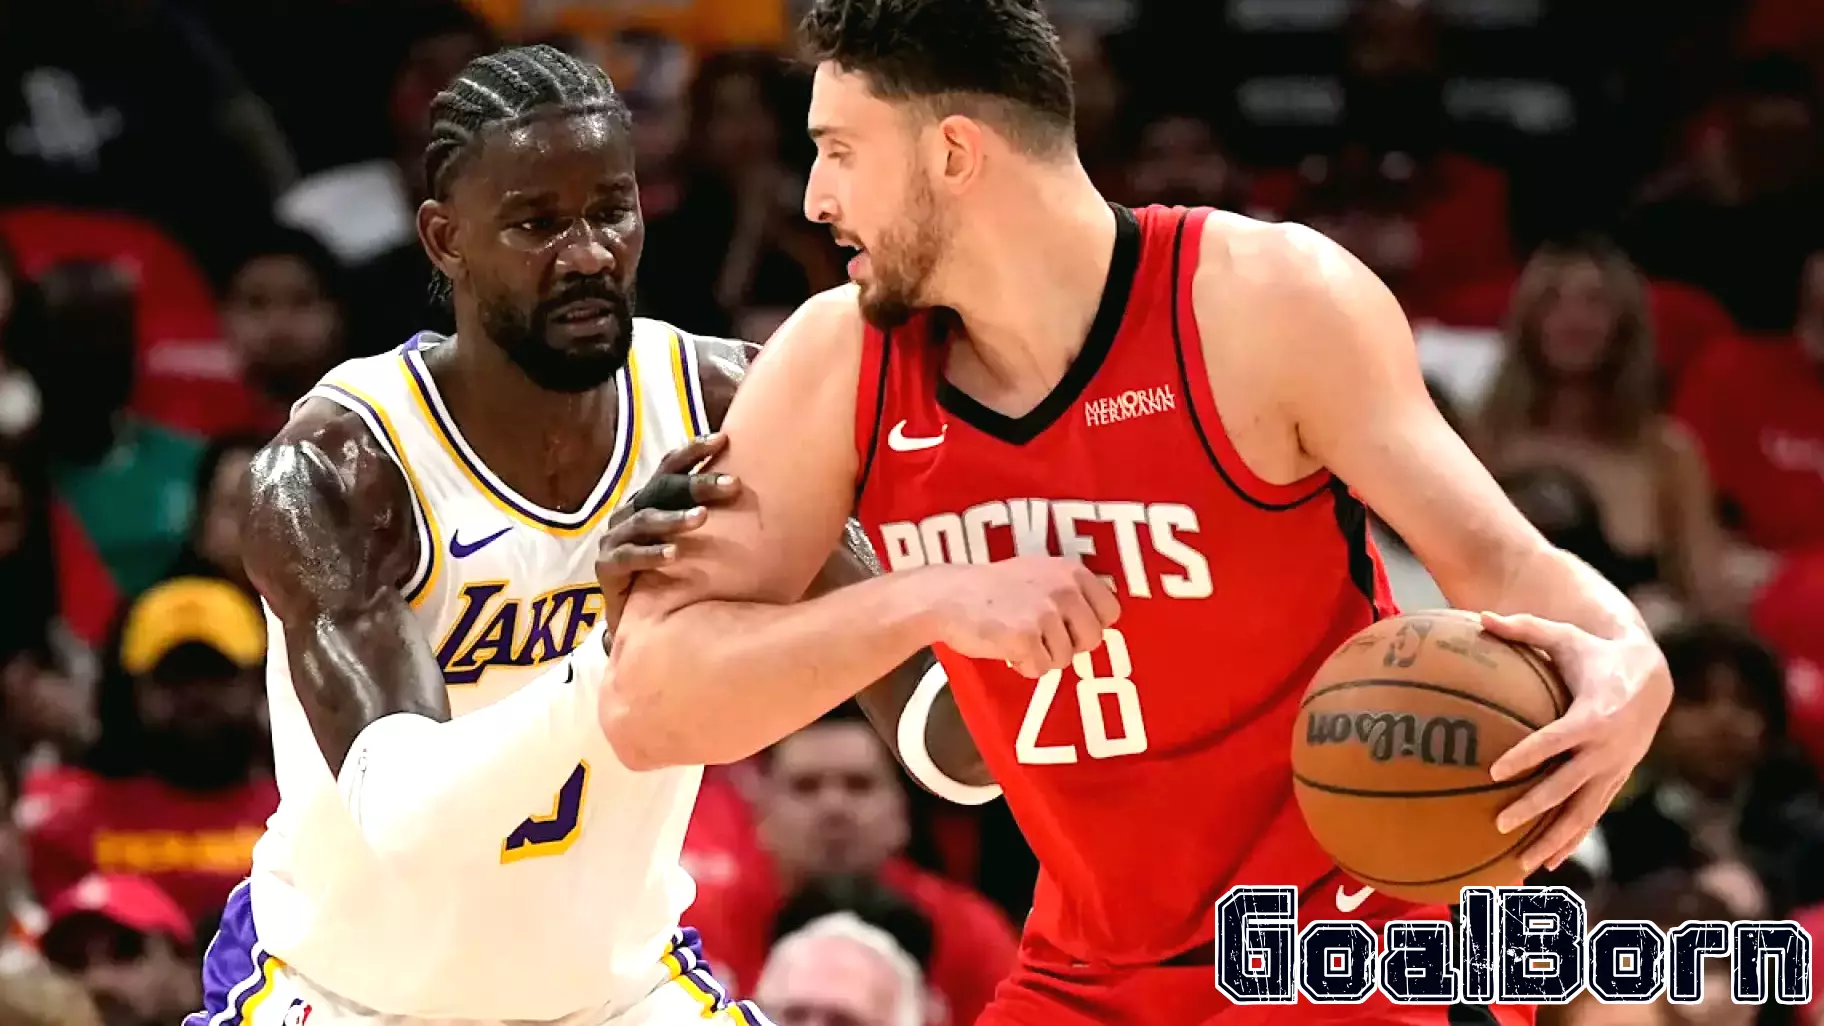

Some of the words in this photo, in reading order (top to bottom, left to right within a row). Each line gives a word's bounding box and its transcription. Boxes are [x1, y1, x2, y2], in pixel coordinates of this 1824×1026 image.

[1084, 384, 1175, 415] MEMORIAL
[1085, 395, 1176, 427] HERMANN
[1305, 711, 1481, 767] Wilson
